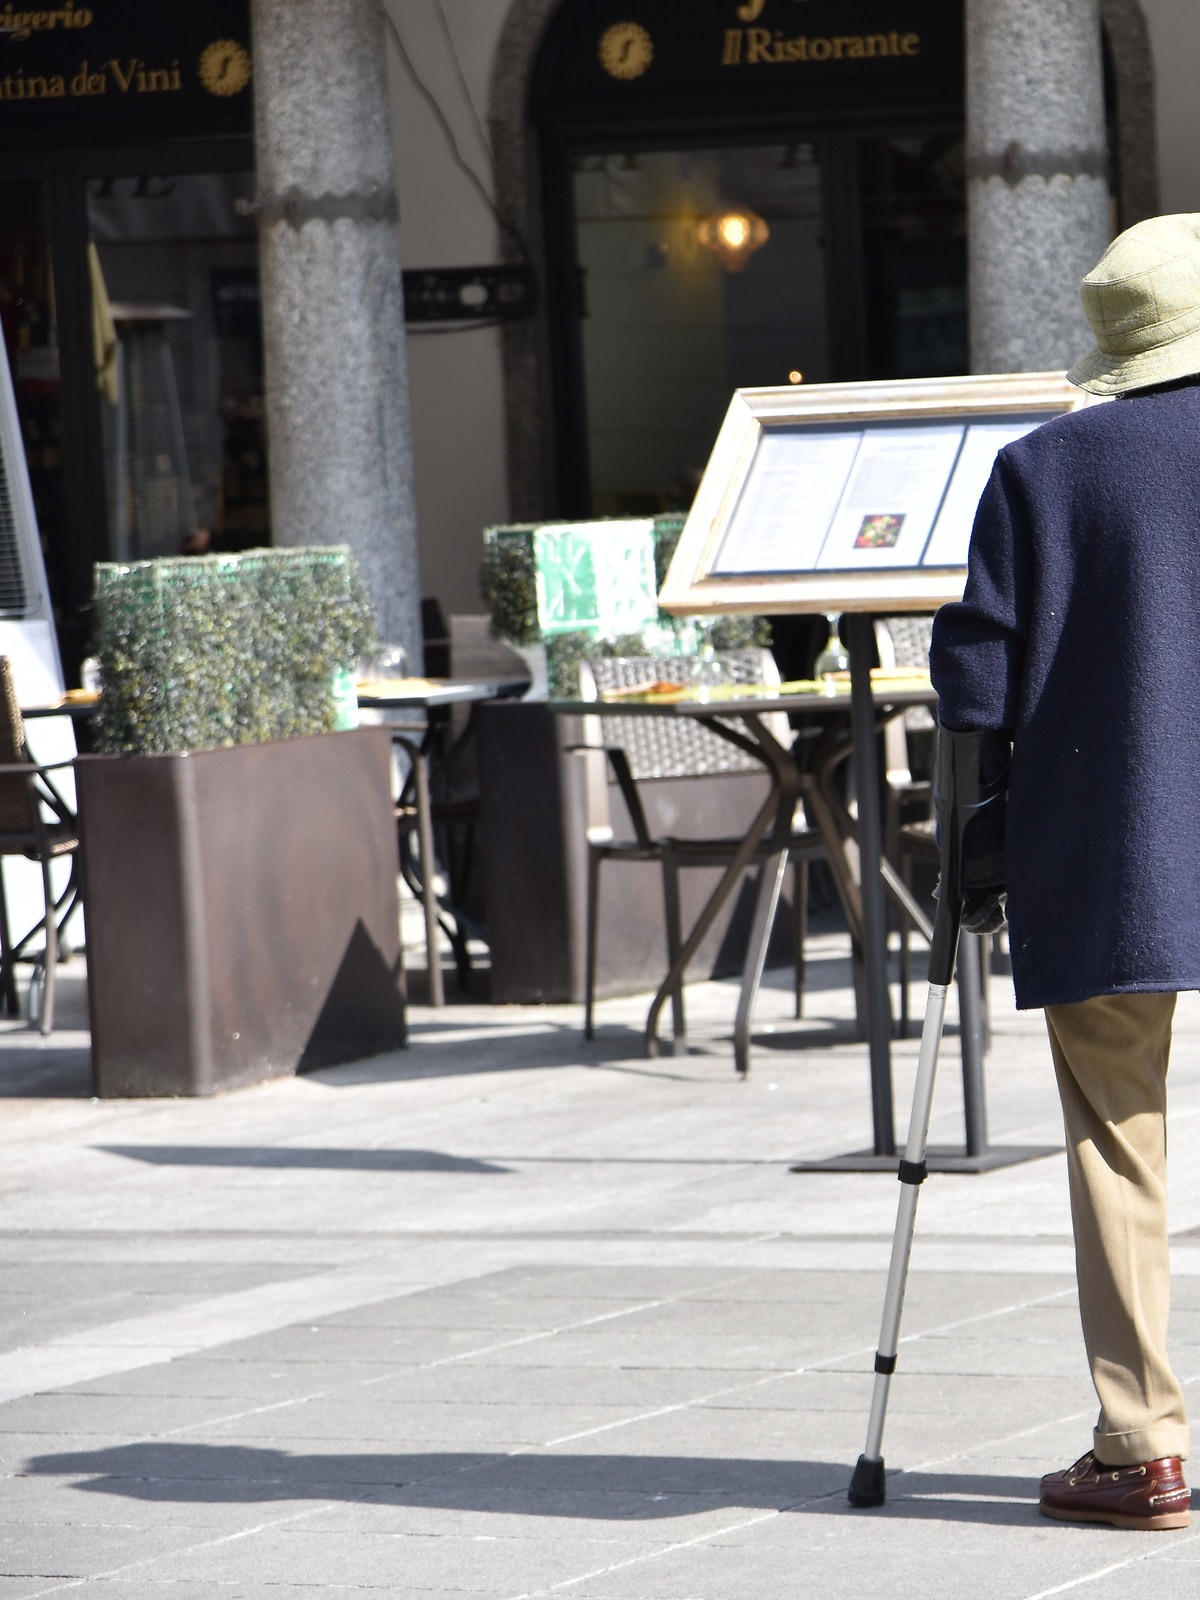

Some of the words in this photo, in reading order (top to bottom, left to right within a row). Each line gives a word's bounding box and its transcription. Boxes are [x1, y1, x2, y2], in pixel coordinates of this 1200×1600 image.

[746, 26, 921, 63] Ristorante
[0, 67, 67, 101] tina
[70, 59, 108, 97] dei
[107, 58, 183, 94] Vini
